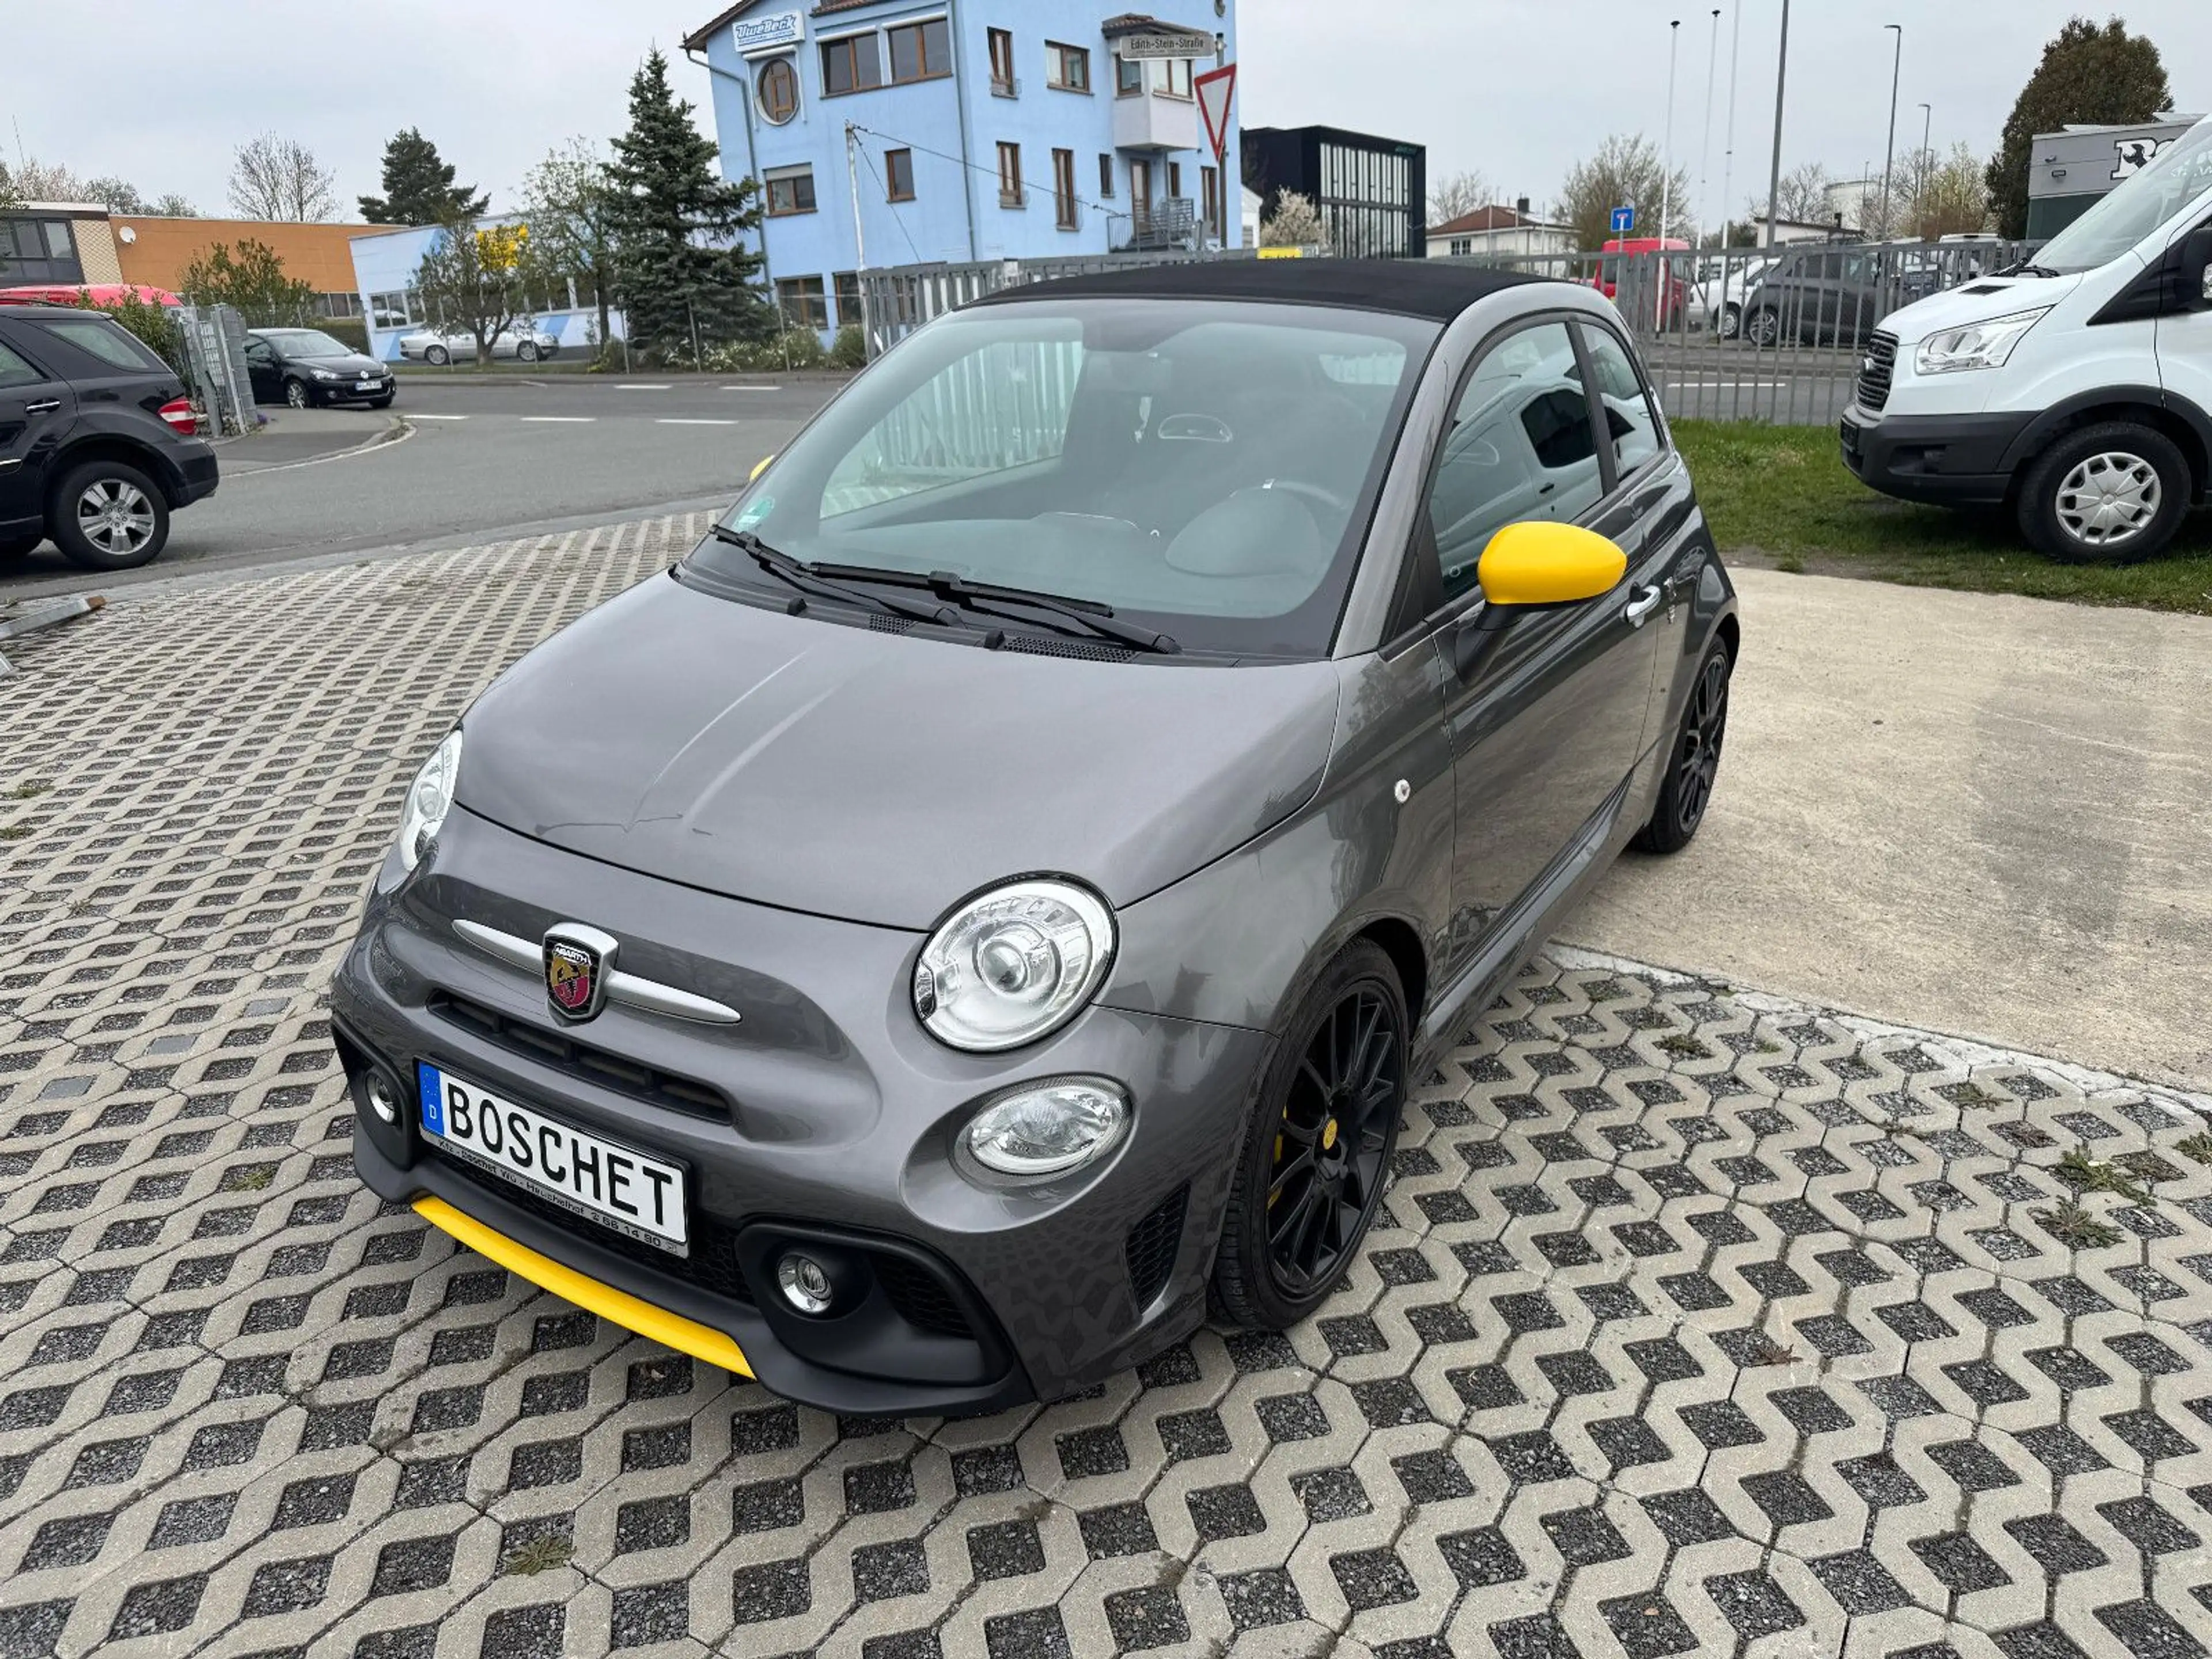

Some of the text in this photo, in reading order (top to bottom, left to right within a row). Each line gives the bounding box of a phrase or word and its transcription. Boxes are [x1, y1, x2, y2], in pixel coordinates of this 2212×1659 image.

[1130, 37, 1204, 50] Edith-Stein-Straße
[555, 946, 588, 964] ABARTH
[429, 1104, 437, 1119] D
[447, 1082, 672, 1226] BOSCHET
[624, 1226, 640, 1238] 14
